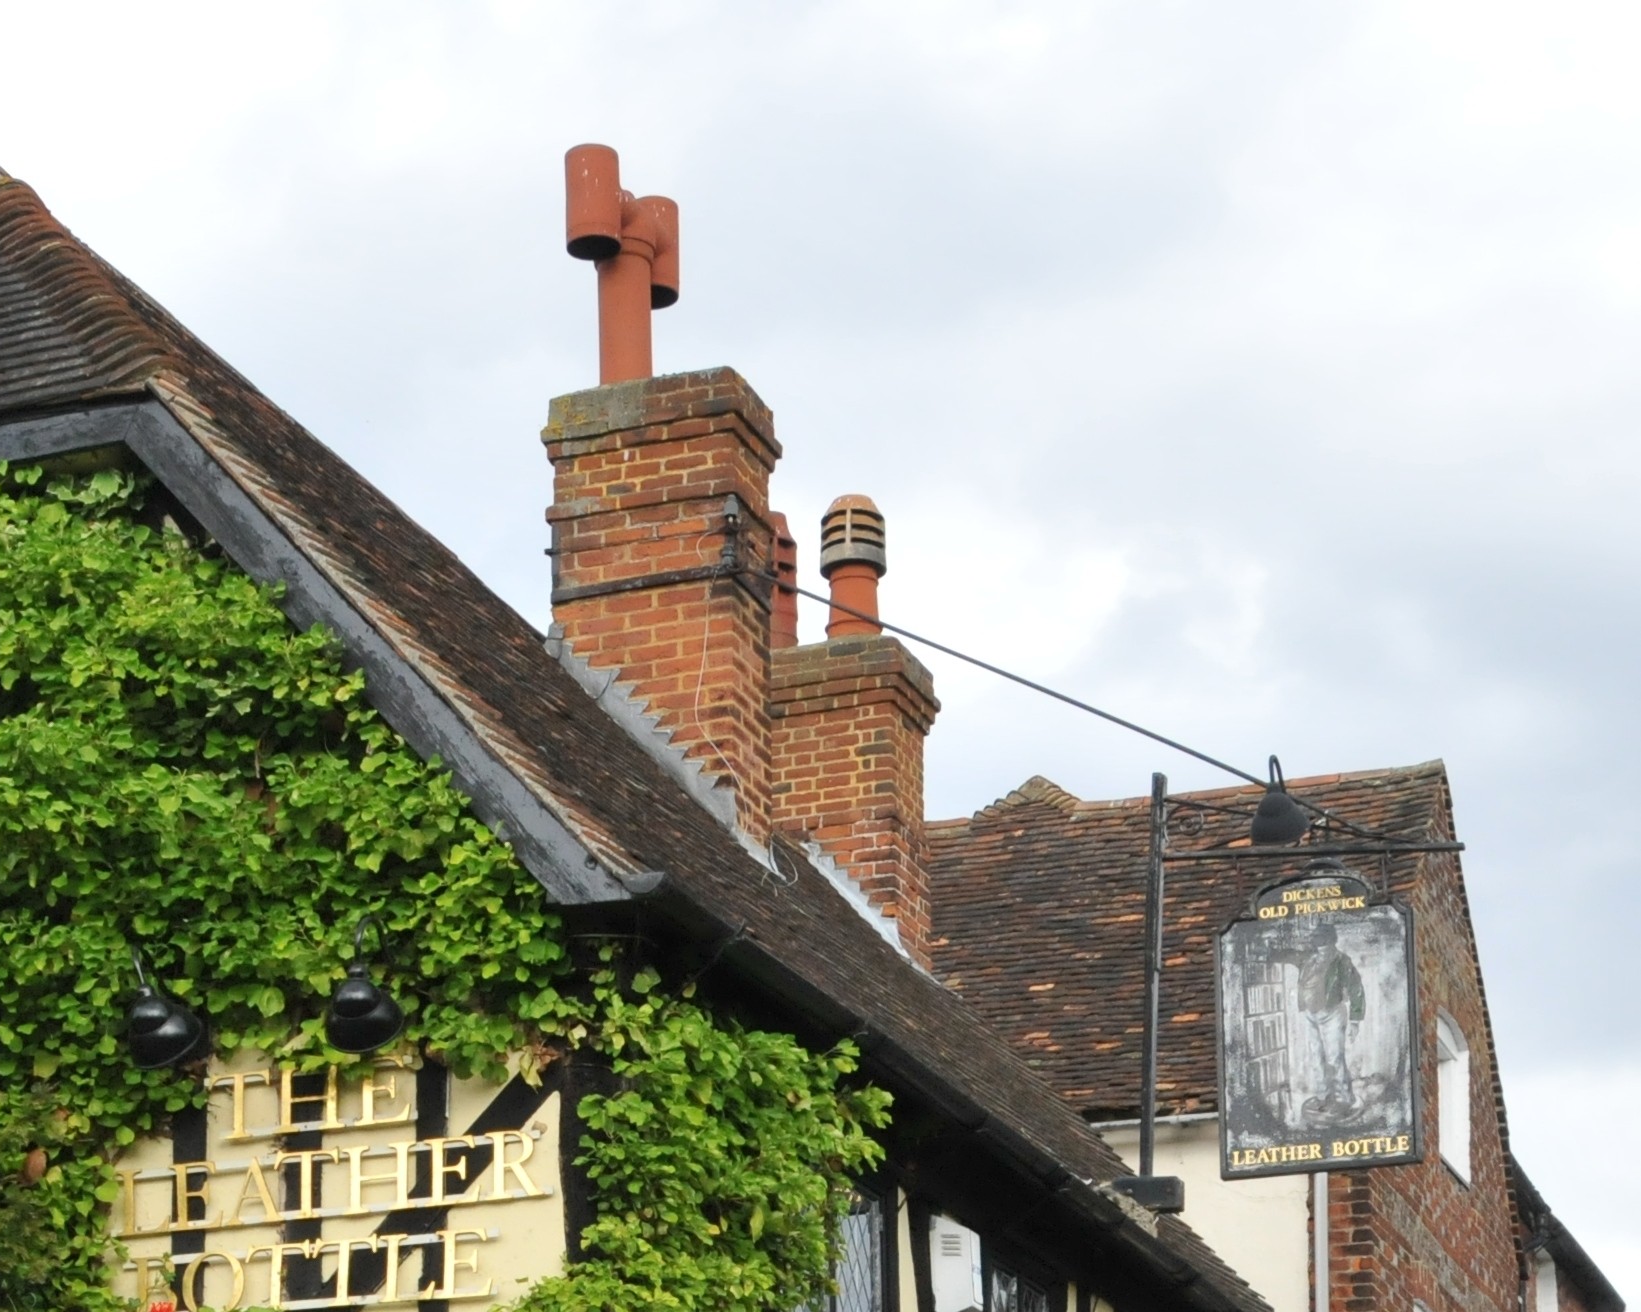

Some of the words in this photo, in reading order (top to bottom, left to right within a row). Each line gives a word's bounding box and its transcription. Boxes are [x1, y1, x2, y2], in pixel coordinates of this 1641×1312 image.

[1259, 905, 1289, 919] OLD
[1294, 896, 1365, 915] PICKWICK
[1282, 885, 1342, 903] DICKENS
[209, 1055, 411, 1141] THE
[1232, 1143, 1323, 1167] LEATHER
[1332, 1135, 1410, 1159] BOTTLE
[116, 1131, 544, 1236] LEATHER
